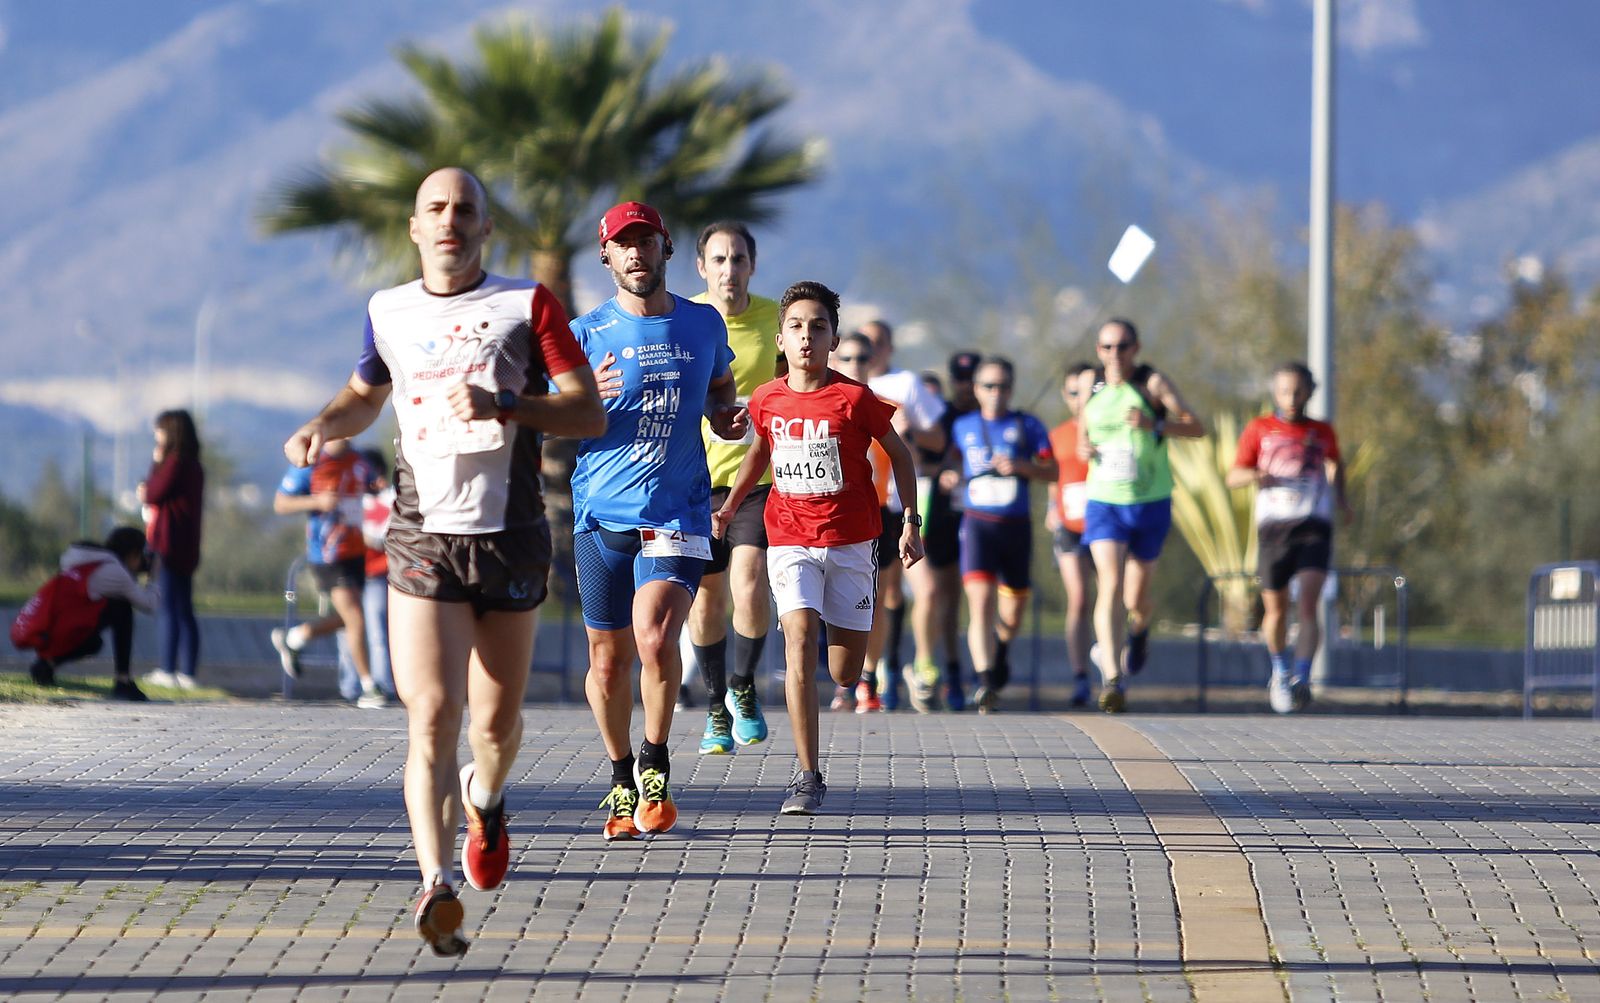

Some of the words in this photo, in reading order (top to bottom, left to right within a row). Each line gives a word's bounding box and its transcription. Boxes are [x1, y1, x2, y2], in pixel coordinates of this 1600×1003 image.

[637, 343, 671, 353] ZURICH
[643, 372, 662, 383] 21K
[810, 450, 829, 458] CAUSA
[783, 461, 826, 479] 4416
